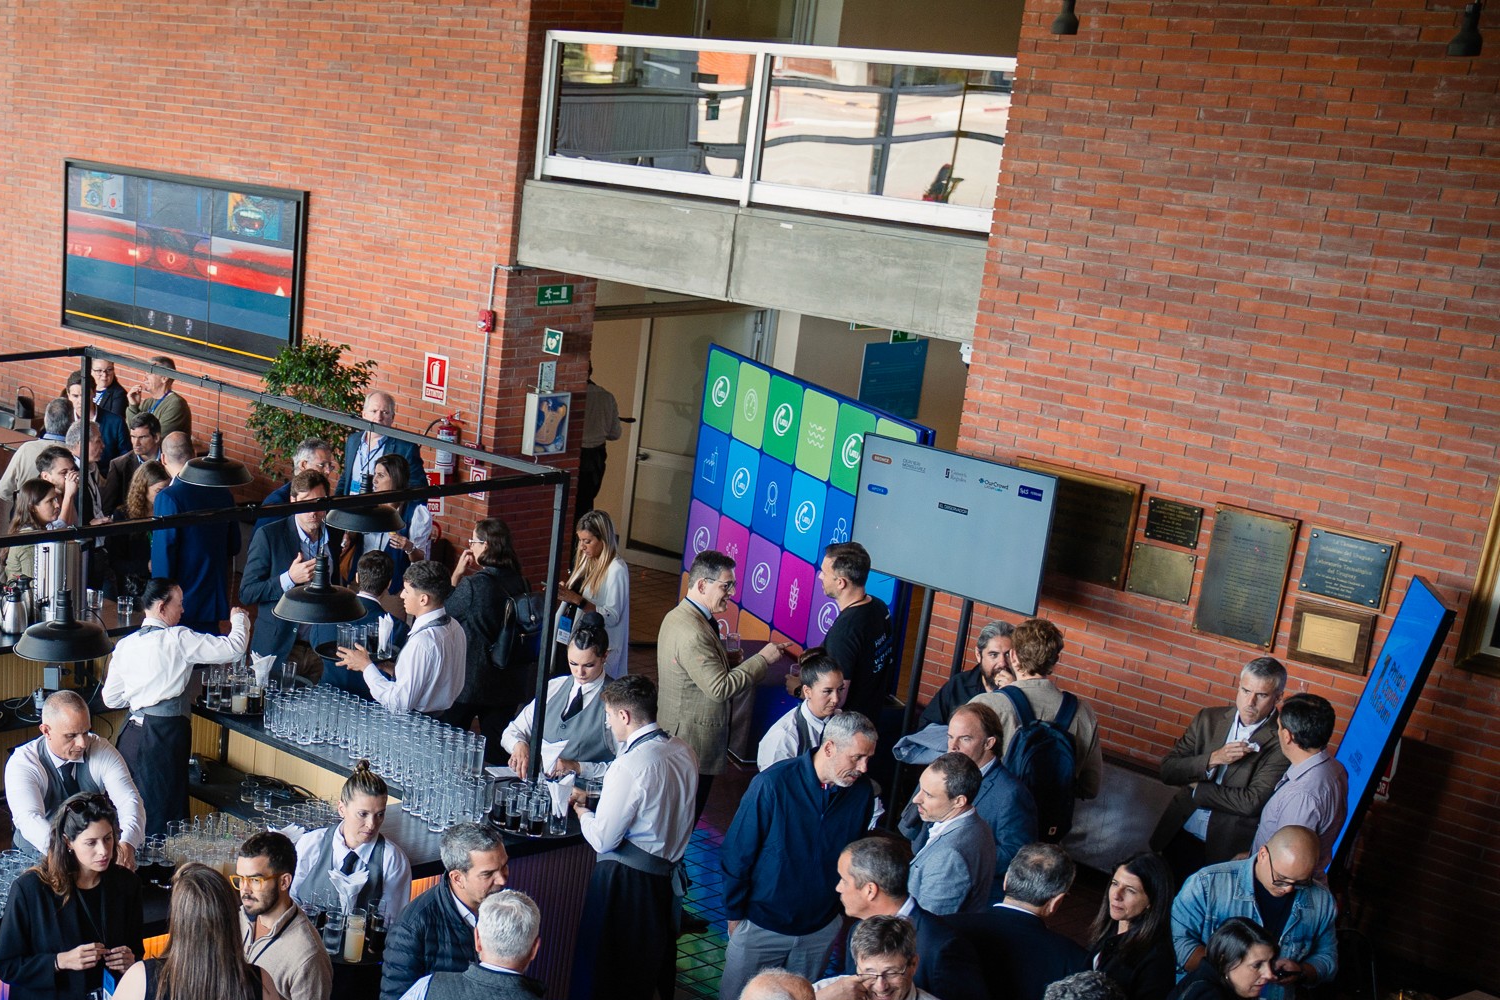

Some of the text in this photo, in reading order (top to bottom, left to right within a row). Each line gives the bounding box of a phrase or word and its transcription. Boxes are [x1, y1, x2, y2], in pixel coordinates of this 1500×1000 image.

[984, 480, 1008, 490] OurCrowd
[1388, 661, 1406, 692] Private
[1382, 679, 1401, 710] Capital
